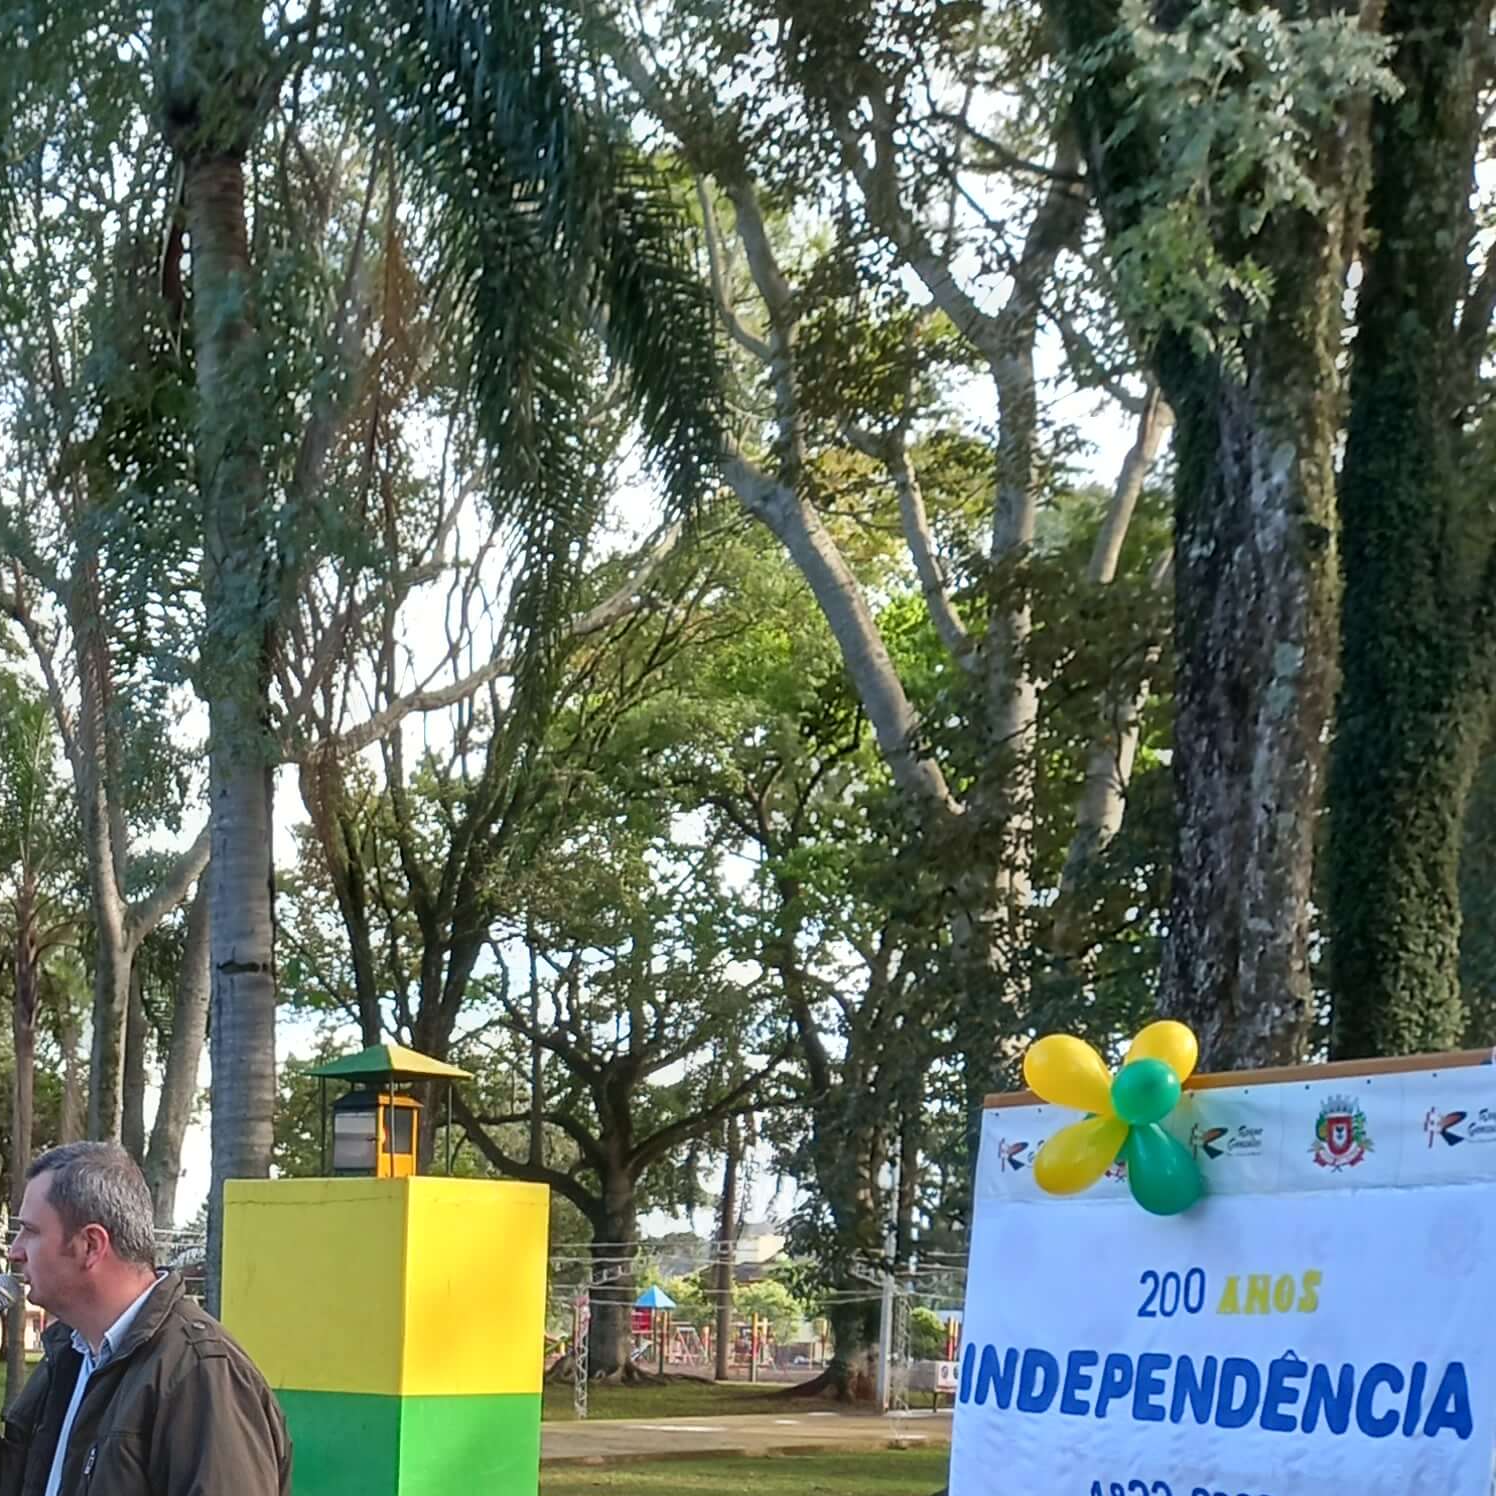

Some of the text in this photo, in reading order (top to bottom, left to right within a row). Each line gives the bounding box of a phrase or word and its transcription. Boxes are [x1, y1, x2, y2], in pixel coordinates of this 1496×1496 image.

[1137, 1267, 1323, 1318] 200 ANOS
[959, 1342, 1473, 1440] INDEPENDÊNCIA
